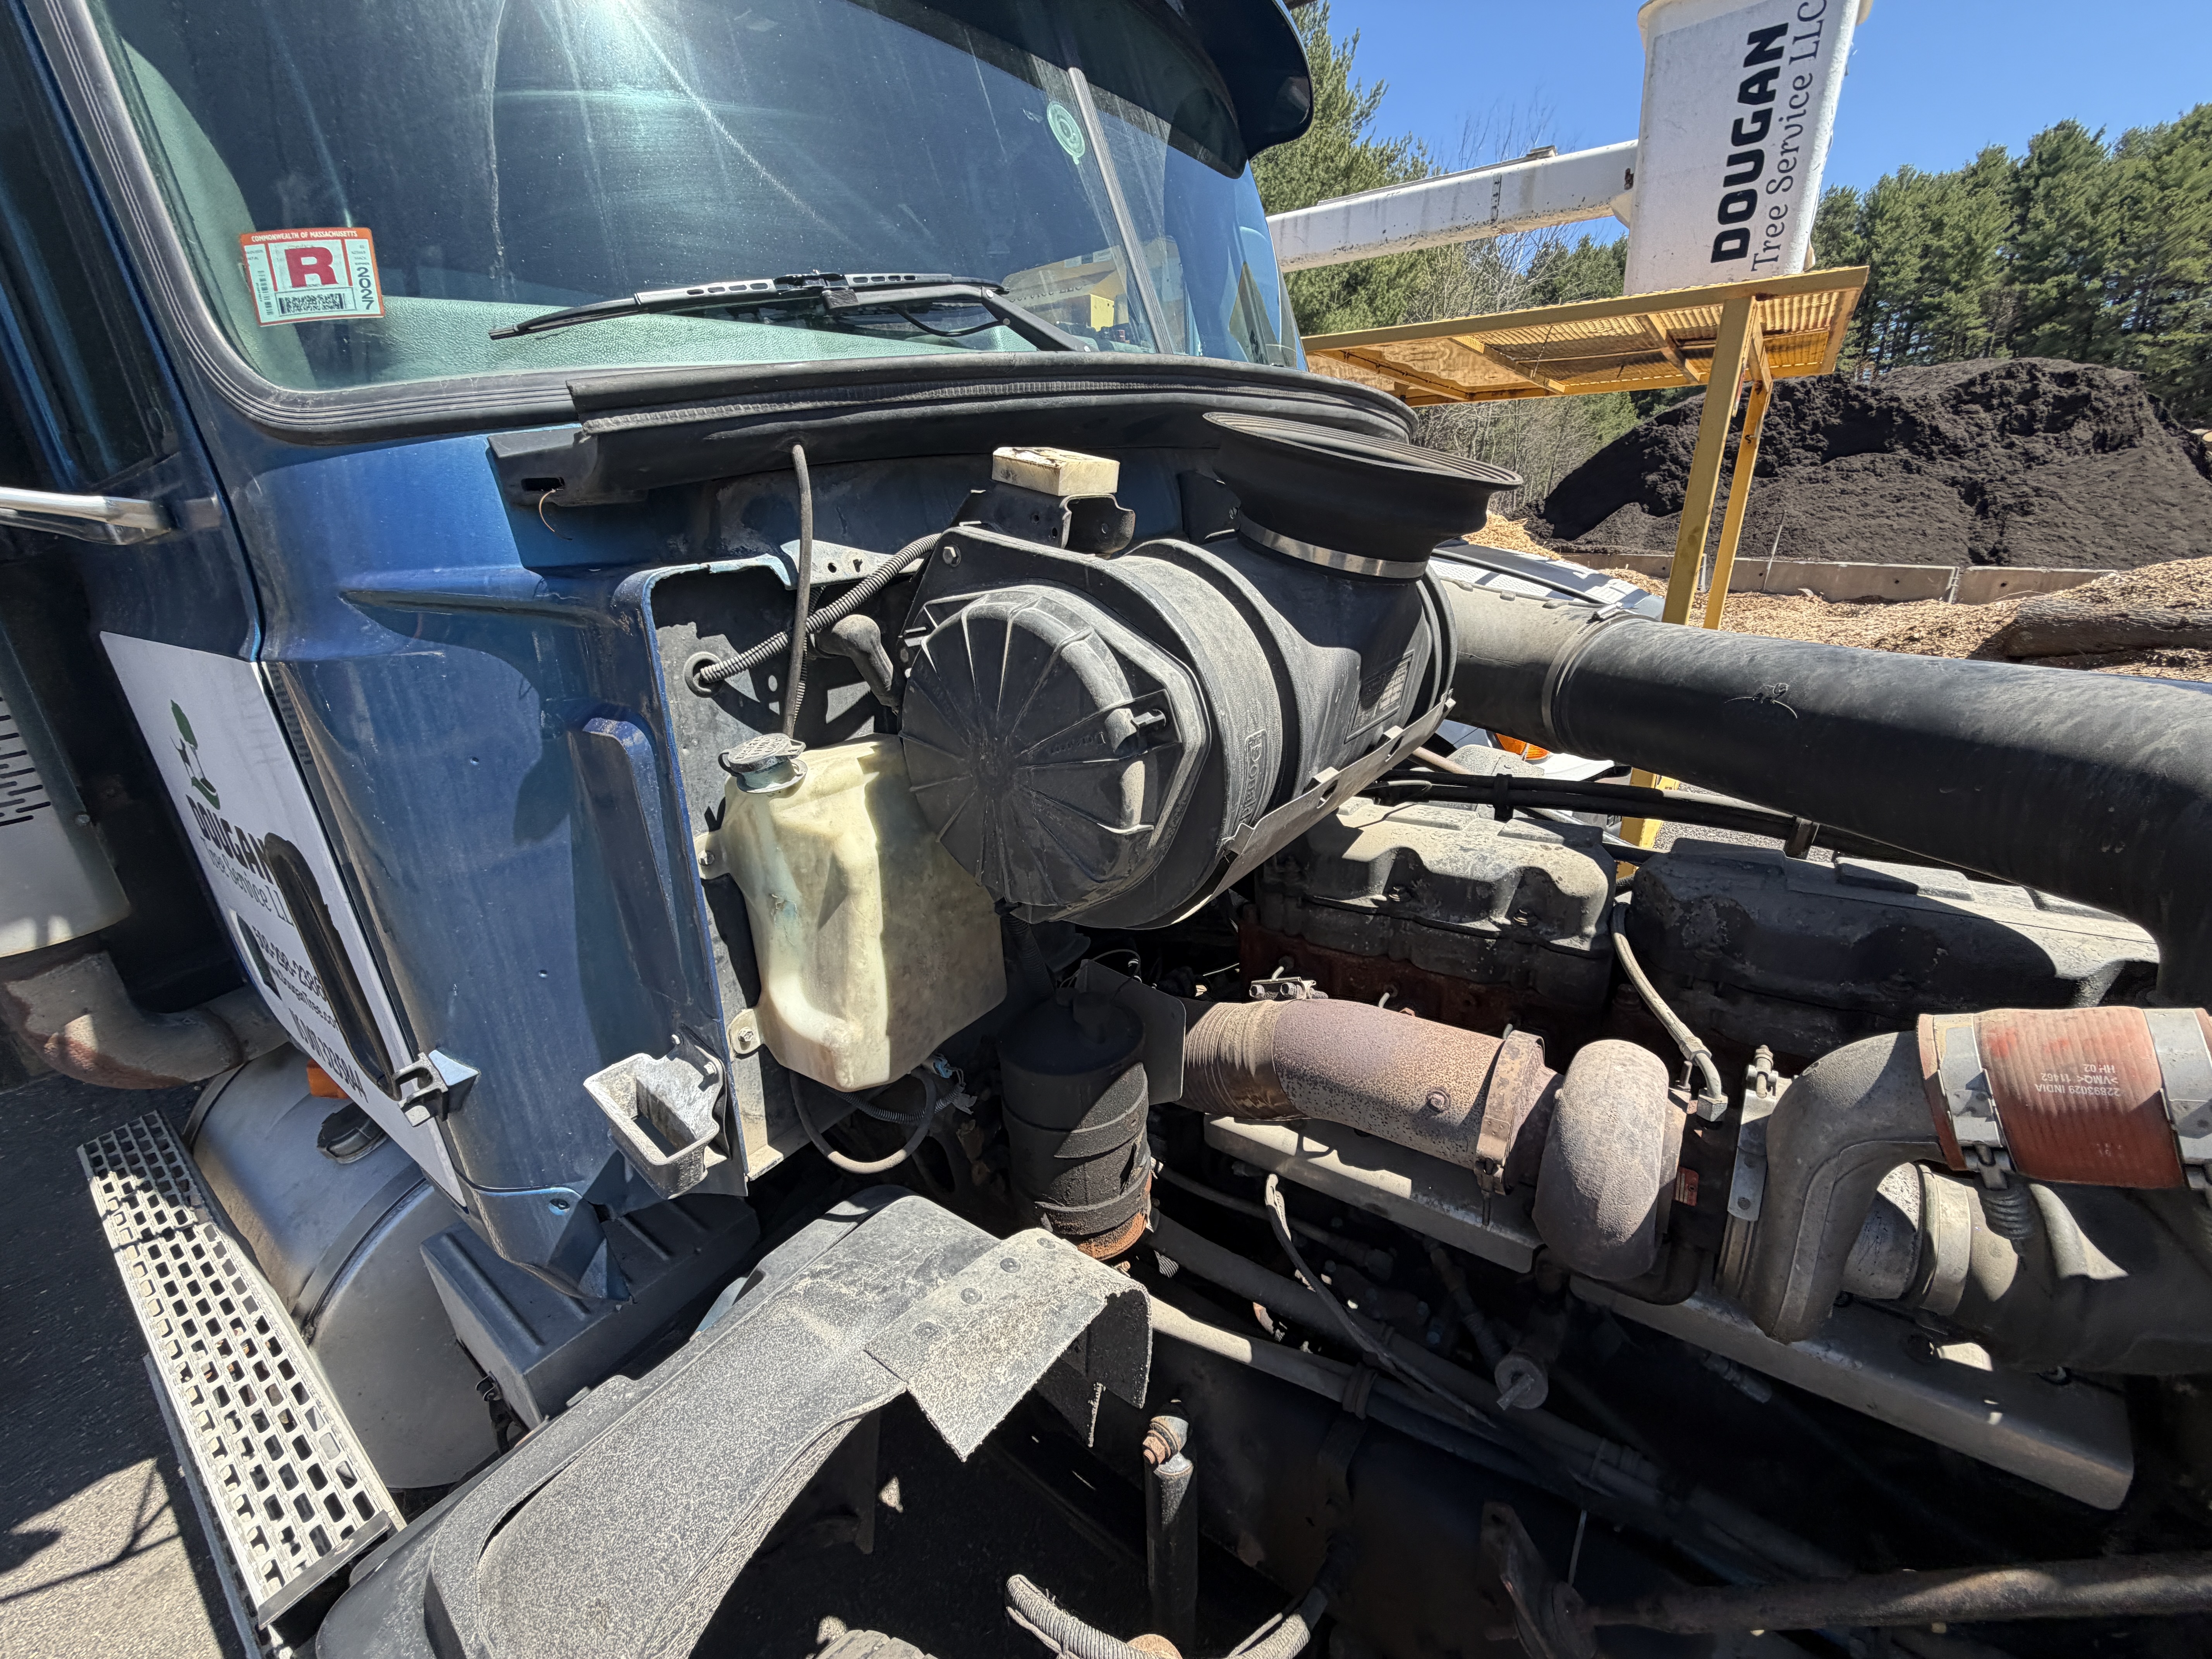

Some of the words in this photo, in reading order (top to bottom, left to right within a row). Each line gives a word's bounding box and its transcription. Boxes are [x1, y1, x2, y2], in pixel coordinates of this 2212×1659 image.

[1789, 0, 1827, 65] LLC
[1711, 22, 1789, 263] DOUGAN
[1766, 72, 1813, 195] Service
[251, 233, 299, 242] COMMONWEALTH
[1751, 204, 1788, 271] Tree
[284, 247, 339, 288] R
[357, 267, 374, 310] 2027
[222, 853, 272, 912] Service
[264, 884, 295, 928] LL
[2034, 1084, 2066, 1093] INDIA
[2041, 1073, 2071, 1083] 11462
[2084, 1064, 2096, 1072] 02
[2068, 1085, 2121, 1097] 22893029
